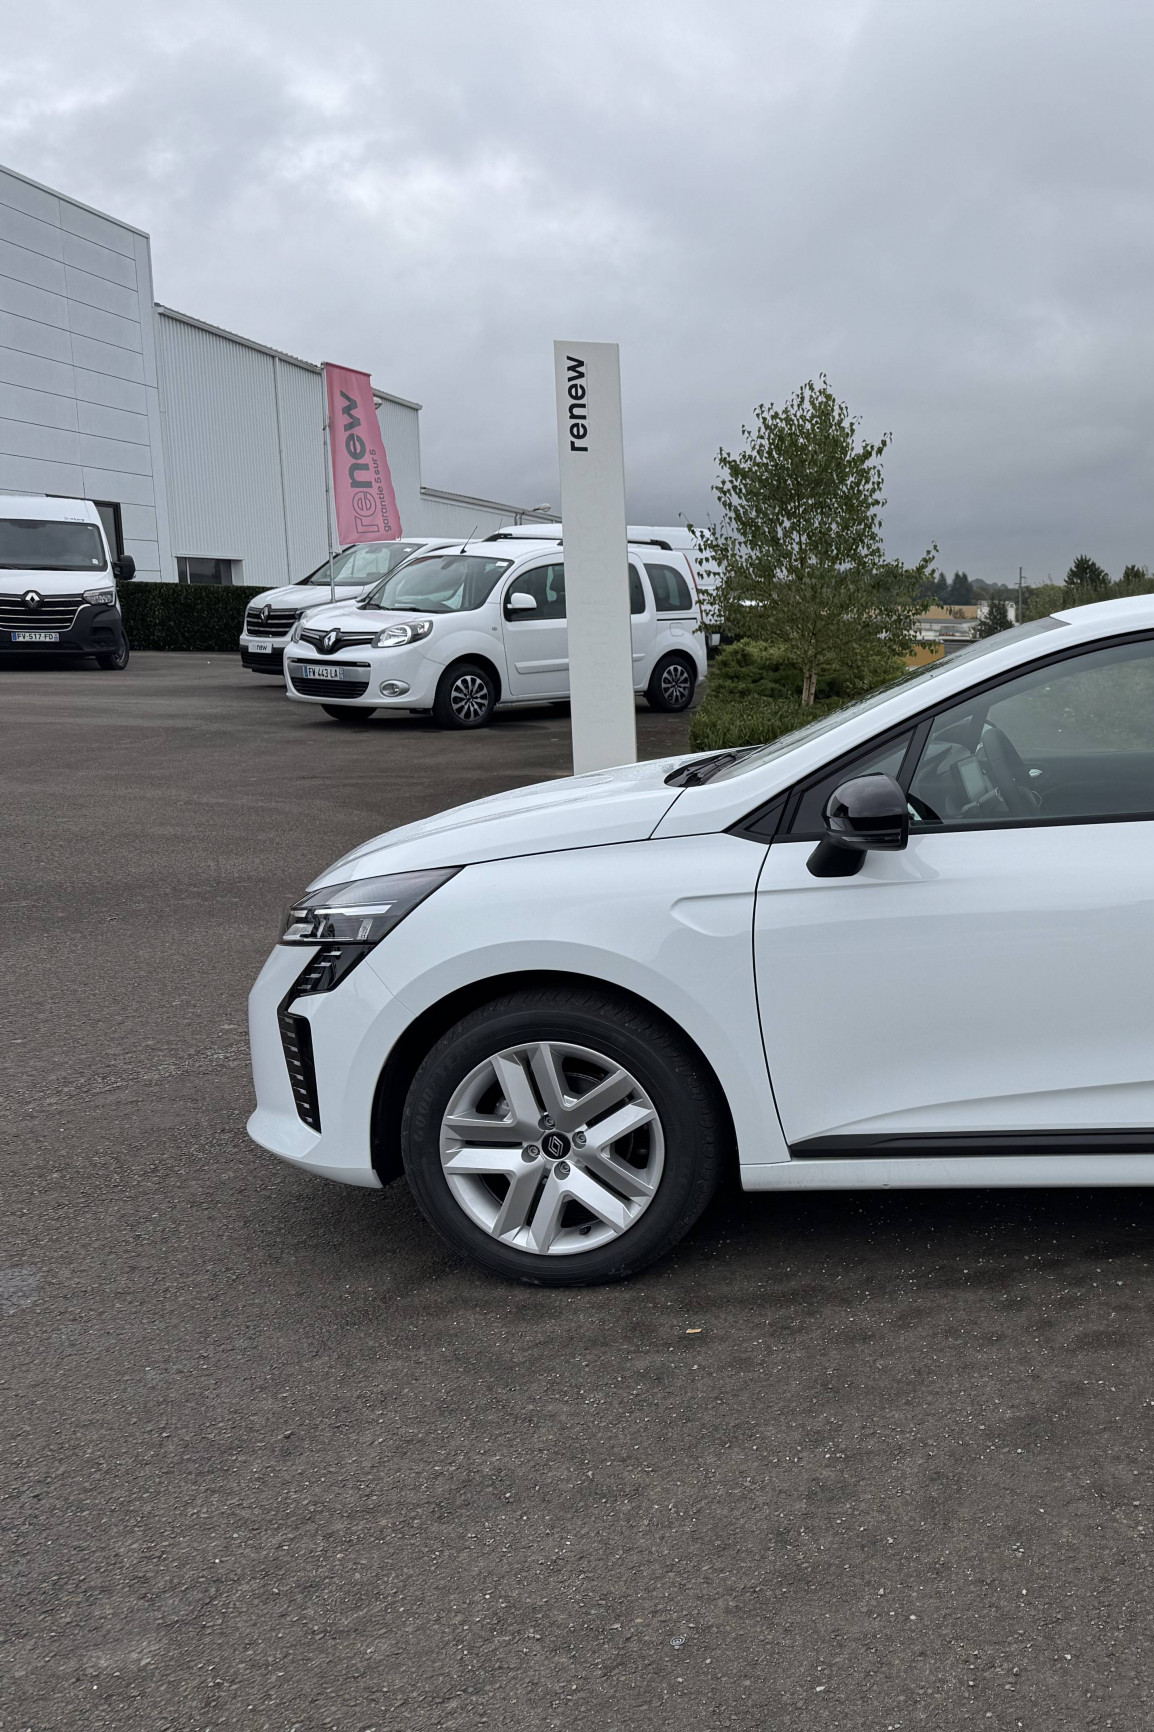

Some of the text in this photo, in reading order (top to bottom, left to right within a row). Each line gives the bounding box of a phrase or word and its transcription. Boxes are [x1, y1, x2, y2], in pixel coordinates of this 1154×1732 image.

[566, 355, 588, 452] renew
[339, 389, 380, 534] renew
[372, 457, 381, 475] sur
[376, 486, 391, 533] garantie
